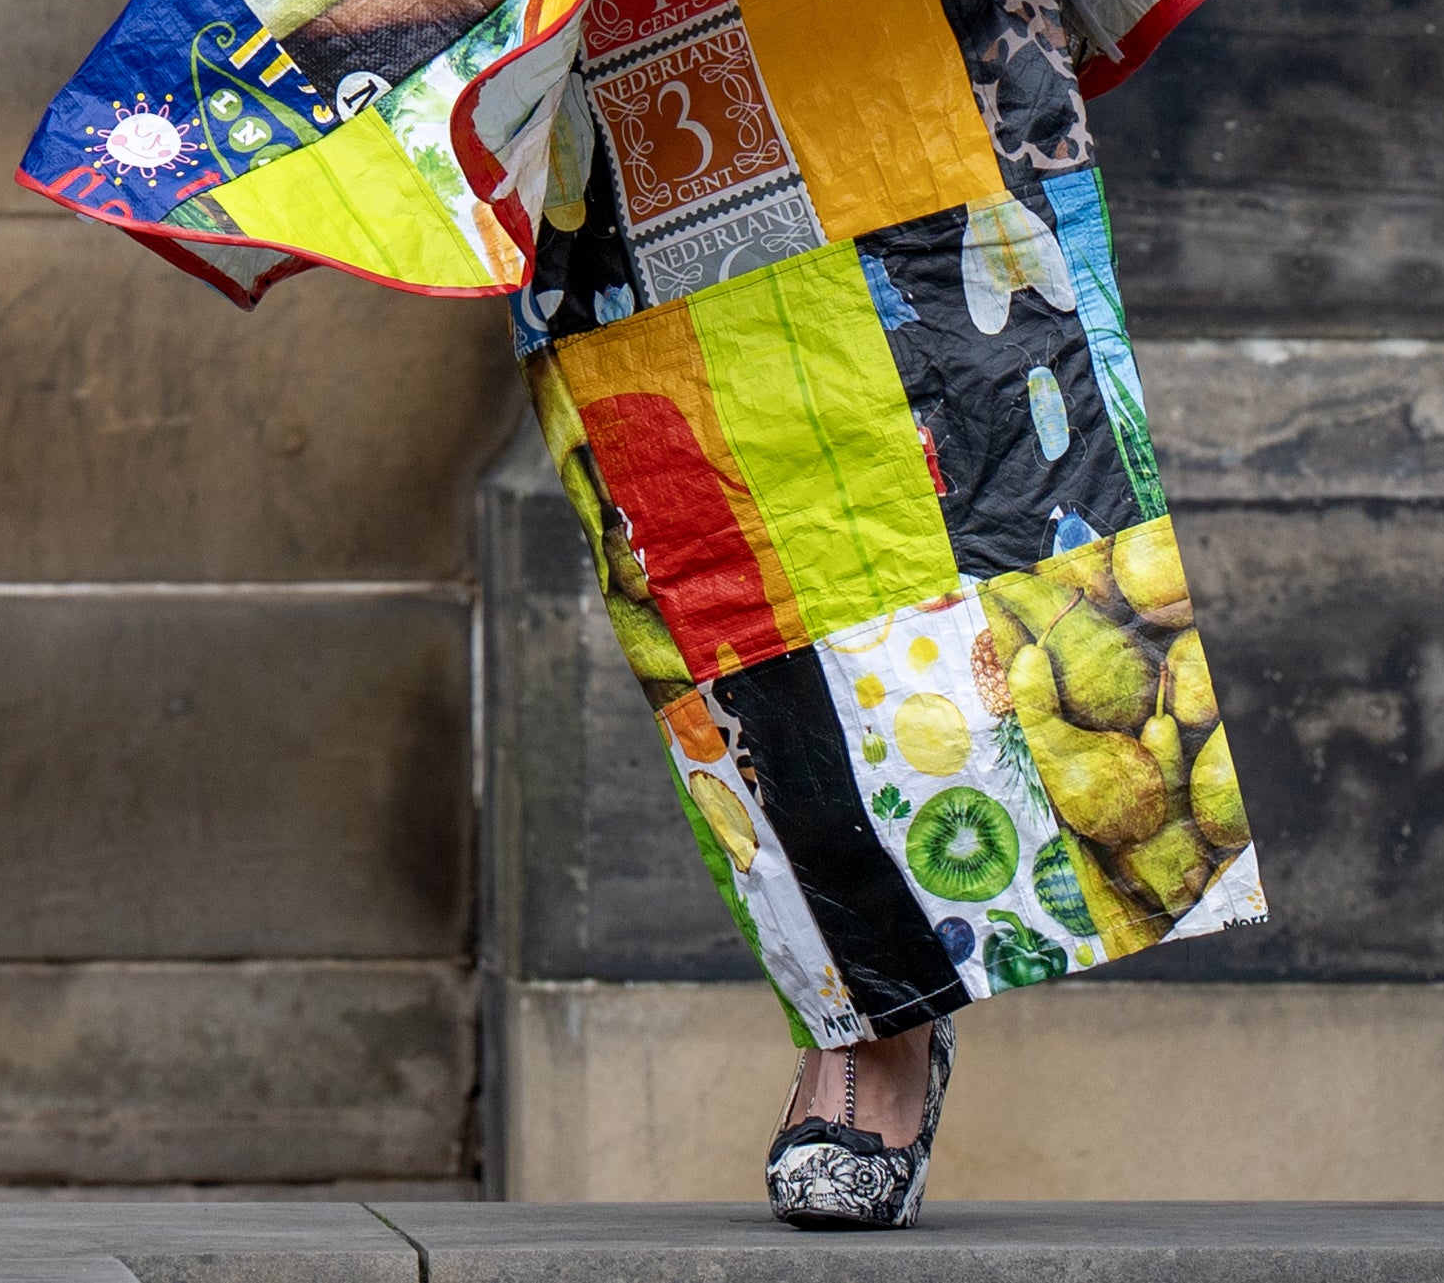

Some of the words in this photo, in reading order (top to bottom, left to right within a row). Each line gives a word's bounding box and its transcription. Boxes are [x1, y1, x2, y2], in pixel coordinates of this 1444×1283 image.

[638, 2, 690, 37] CENT
[595, 29, 746, 109] NEDERLAND
[657, 80, 713, 182] 3
[676, 166, 733, 203] CENT
[646, 197, 805, 276] NEDERLAND
